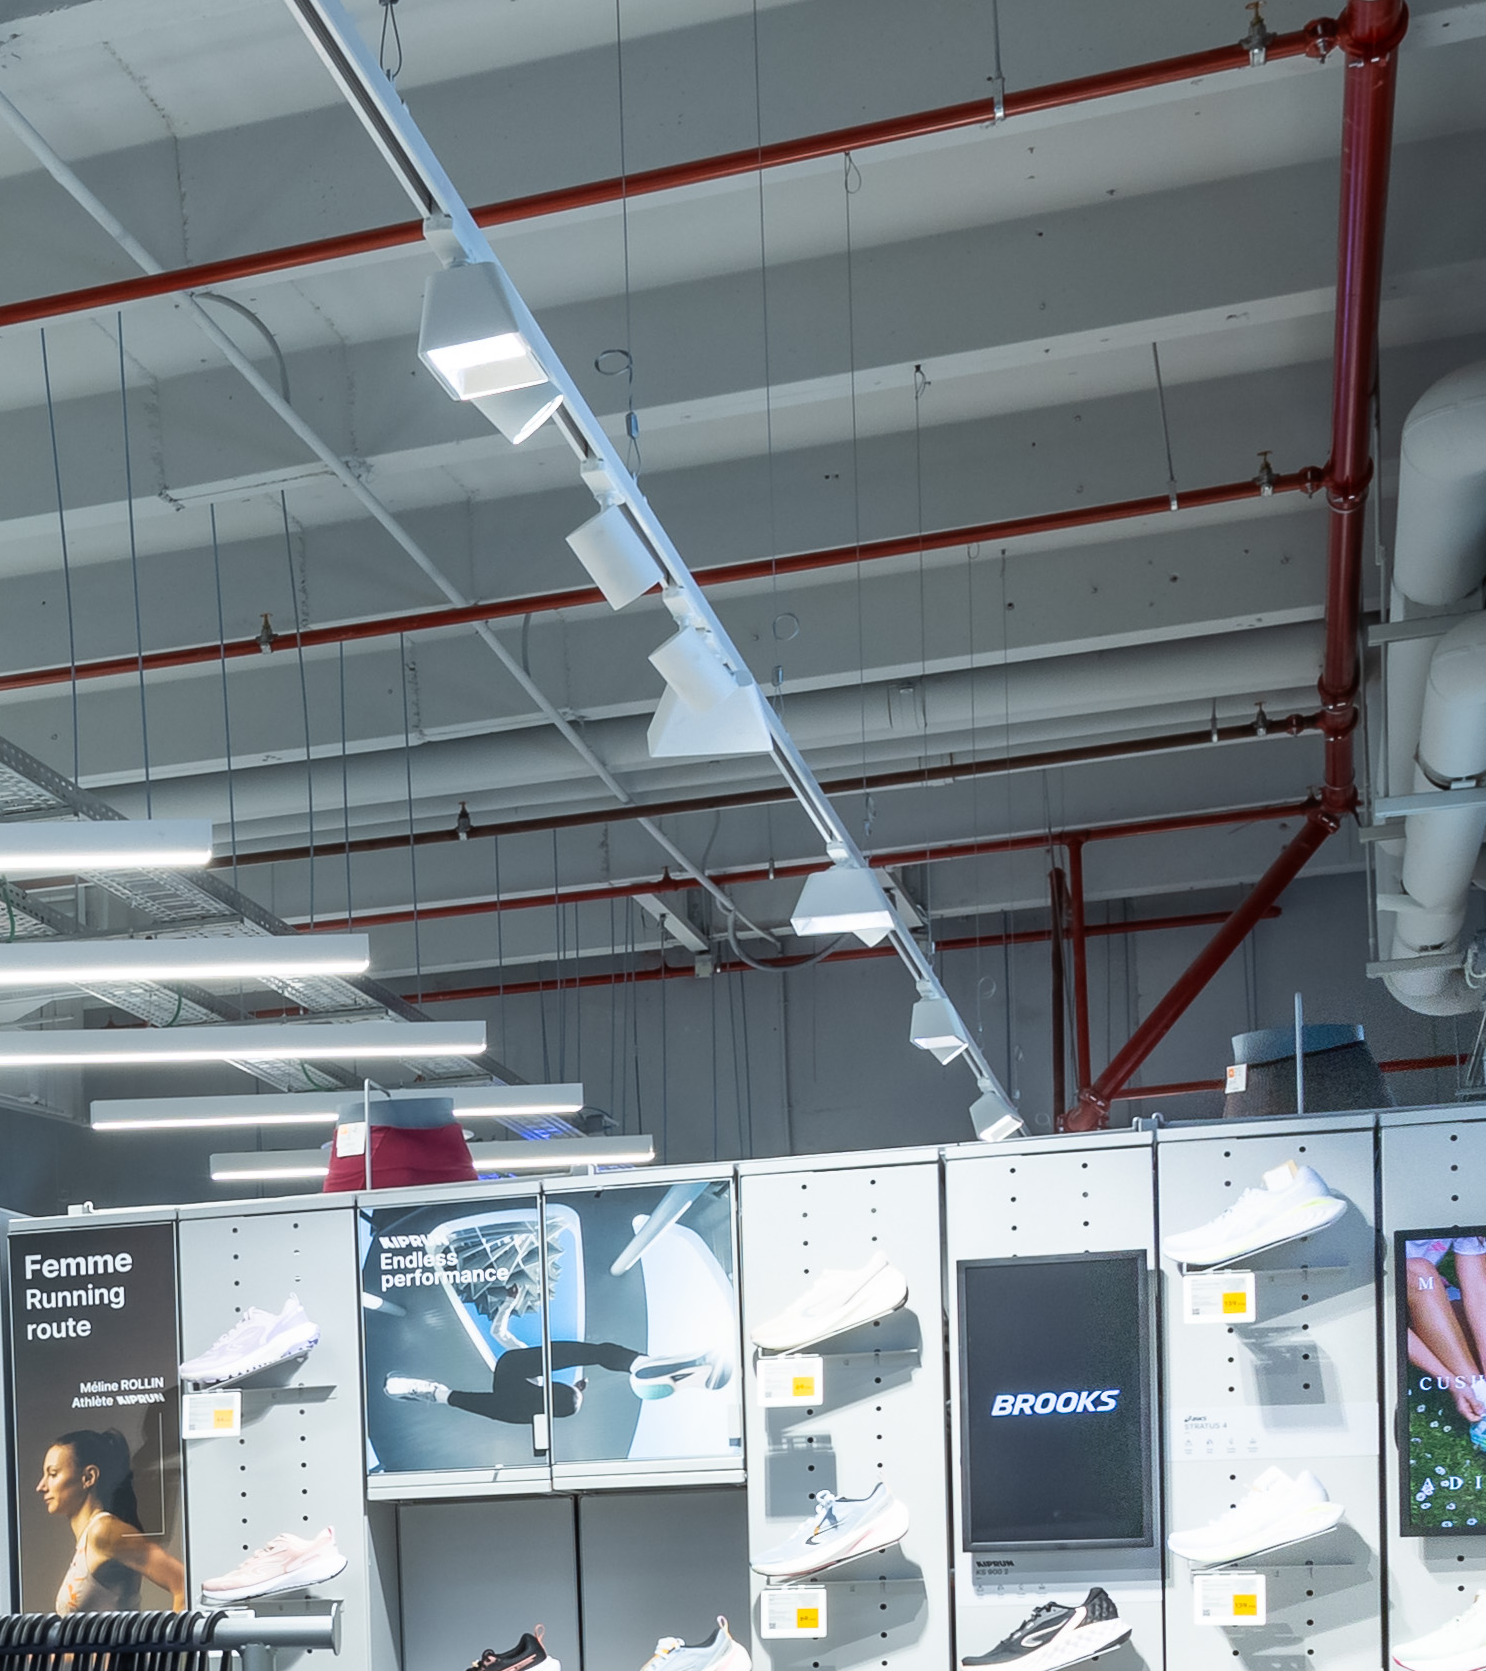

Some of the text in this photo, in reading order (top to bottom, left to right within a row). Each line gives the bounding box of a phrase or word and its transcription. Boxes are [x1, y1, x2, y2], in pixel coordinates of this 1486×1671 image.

[24, 1251, 133, 1280] Femme
[379, 1248, 458, 1270] Endless
[380, 1266, 509, 1292] performance
[25, 1283, 126, 1310] Running
[26, 1317, 92, 1341] route
[79, 1377, 165, 1394] Méline ROLLIN
[71, 1394, 114, 1409] Athlète
[991, 1389, 1121, 1417] BROOKS
